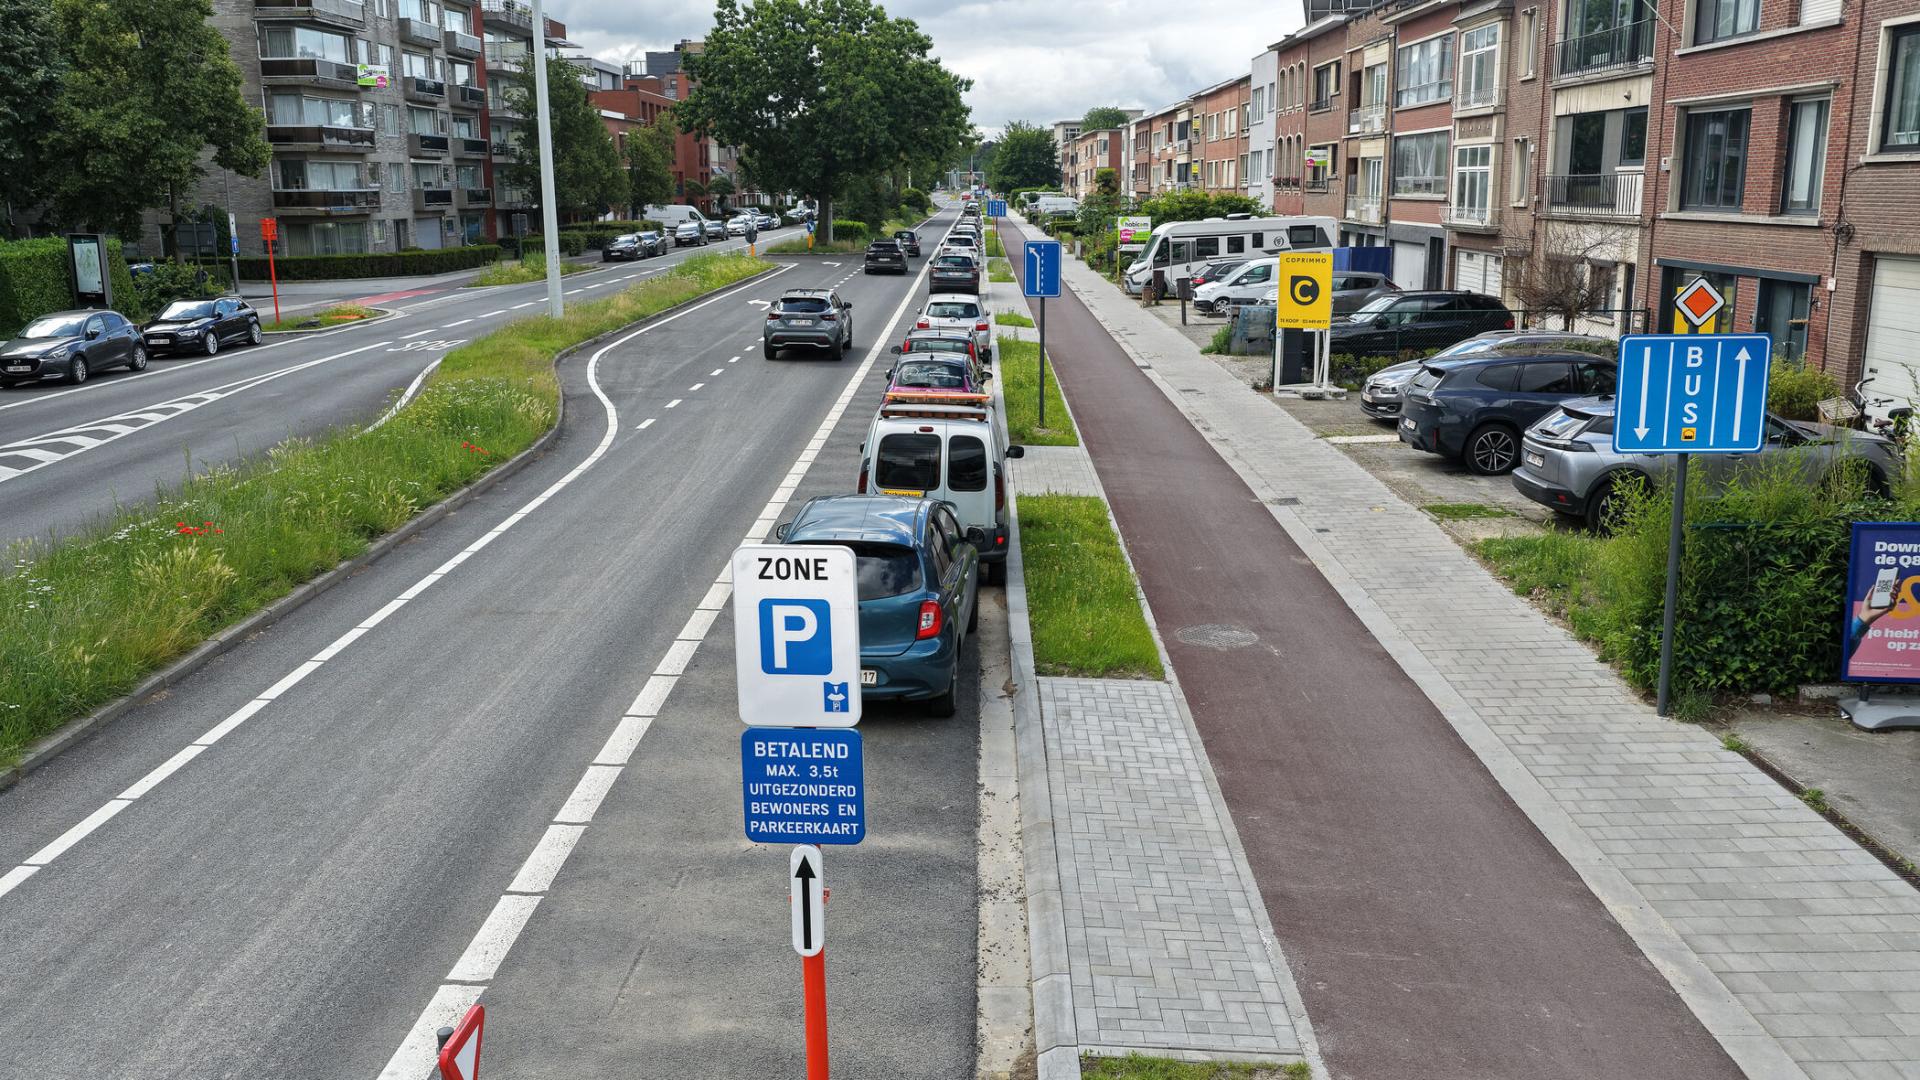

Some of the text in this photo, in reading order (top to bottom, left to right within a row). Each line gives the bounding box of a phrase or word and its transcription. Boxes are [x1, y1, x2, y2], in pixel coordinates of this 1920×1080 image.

[1682, 346, 1703, 424] BUS
[1874, 554, 1897, 565] de
[758, 557, 828, 580] ZONE
[772, 604, 818, 669] P
[1867, 627, 1919, 640] je hebt
[1887, 641, 1907, 651] op
[754, 741, 849, 759] BETALEND
[766, 764, 839, 778] MAX. 3,5t
[749, 783, 856, 797] UITGEZONDERD
[751, 802, 857, 816] BEWONERS EN
[750, 821, 859, 835] PARKEERKAART
